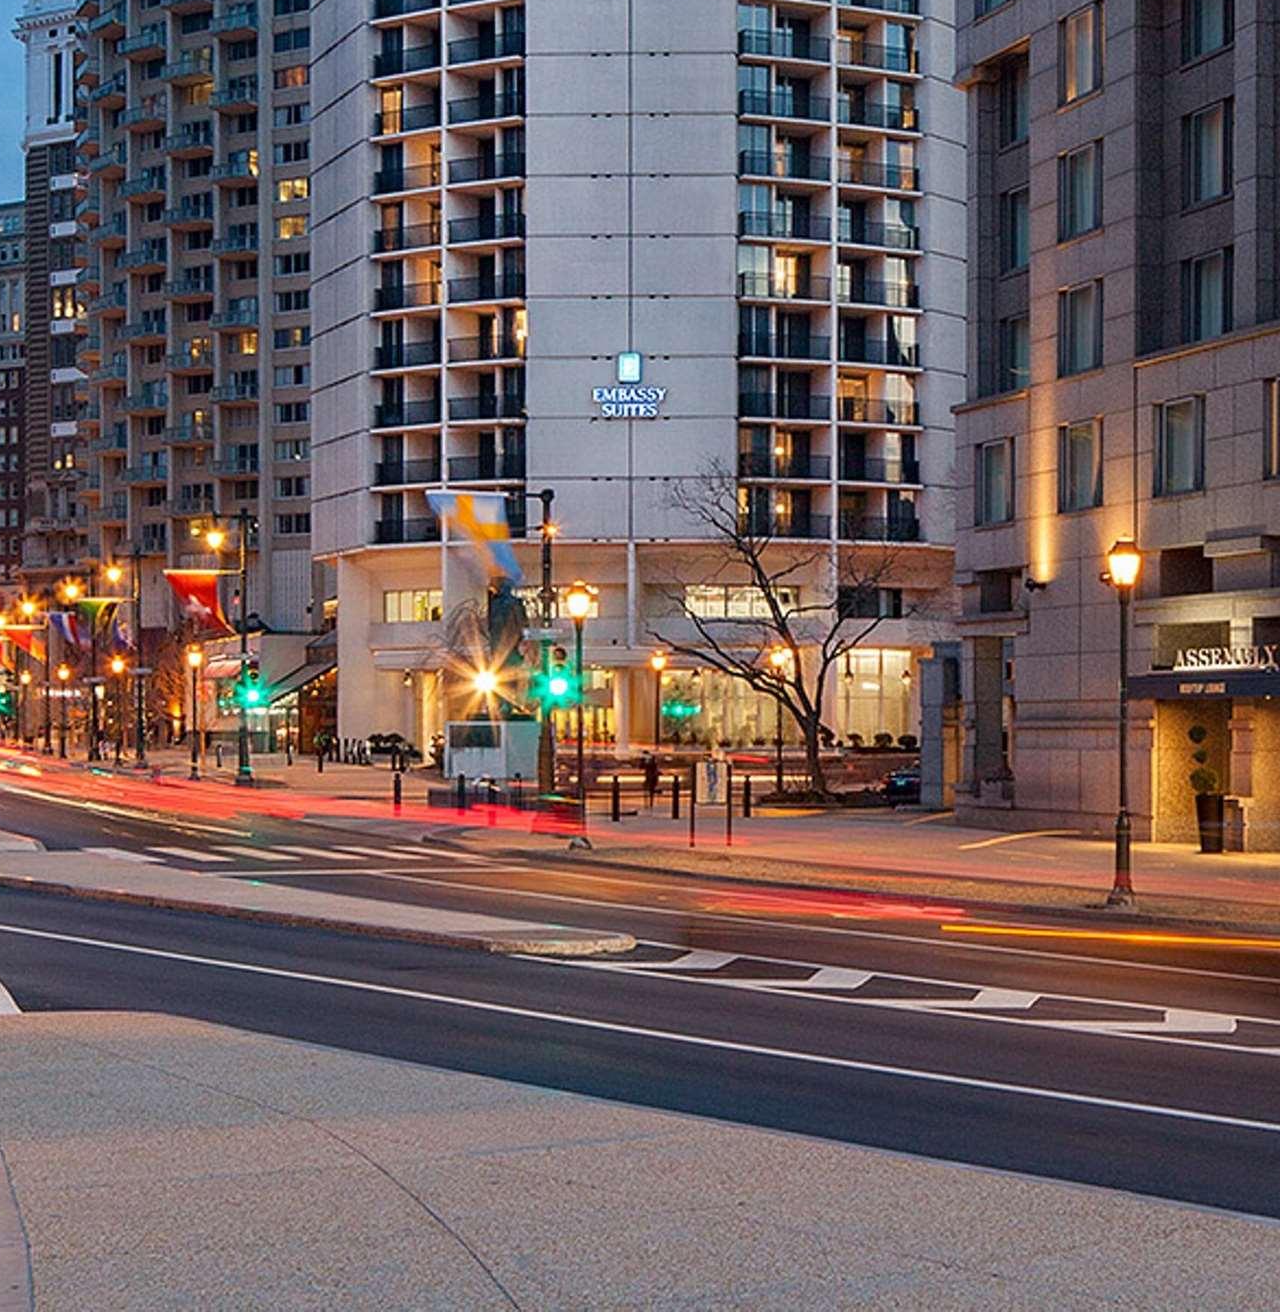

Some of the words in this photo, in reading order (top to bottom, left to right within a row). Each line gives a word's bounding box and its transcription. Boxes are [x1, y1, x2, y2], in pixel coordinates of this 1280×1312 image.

[592, 388, 666, 402] EMBASSY
[601, 403, 658, 417] SUITES
[1174, 645, 1279, 671] ASSEMBLY
